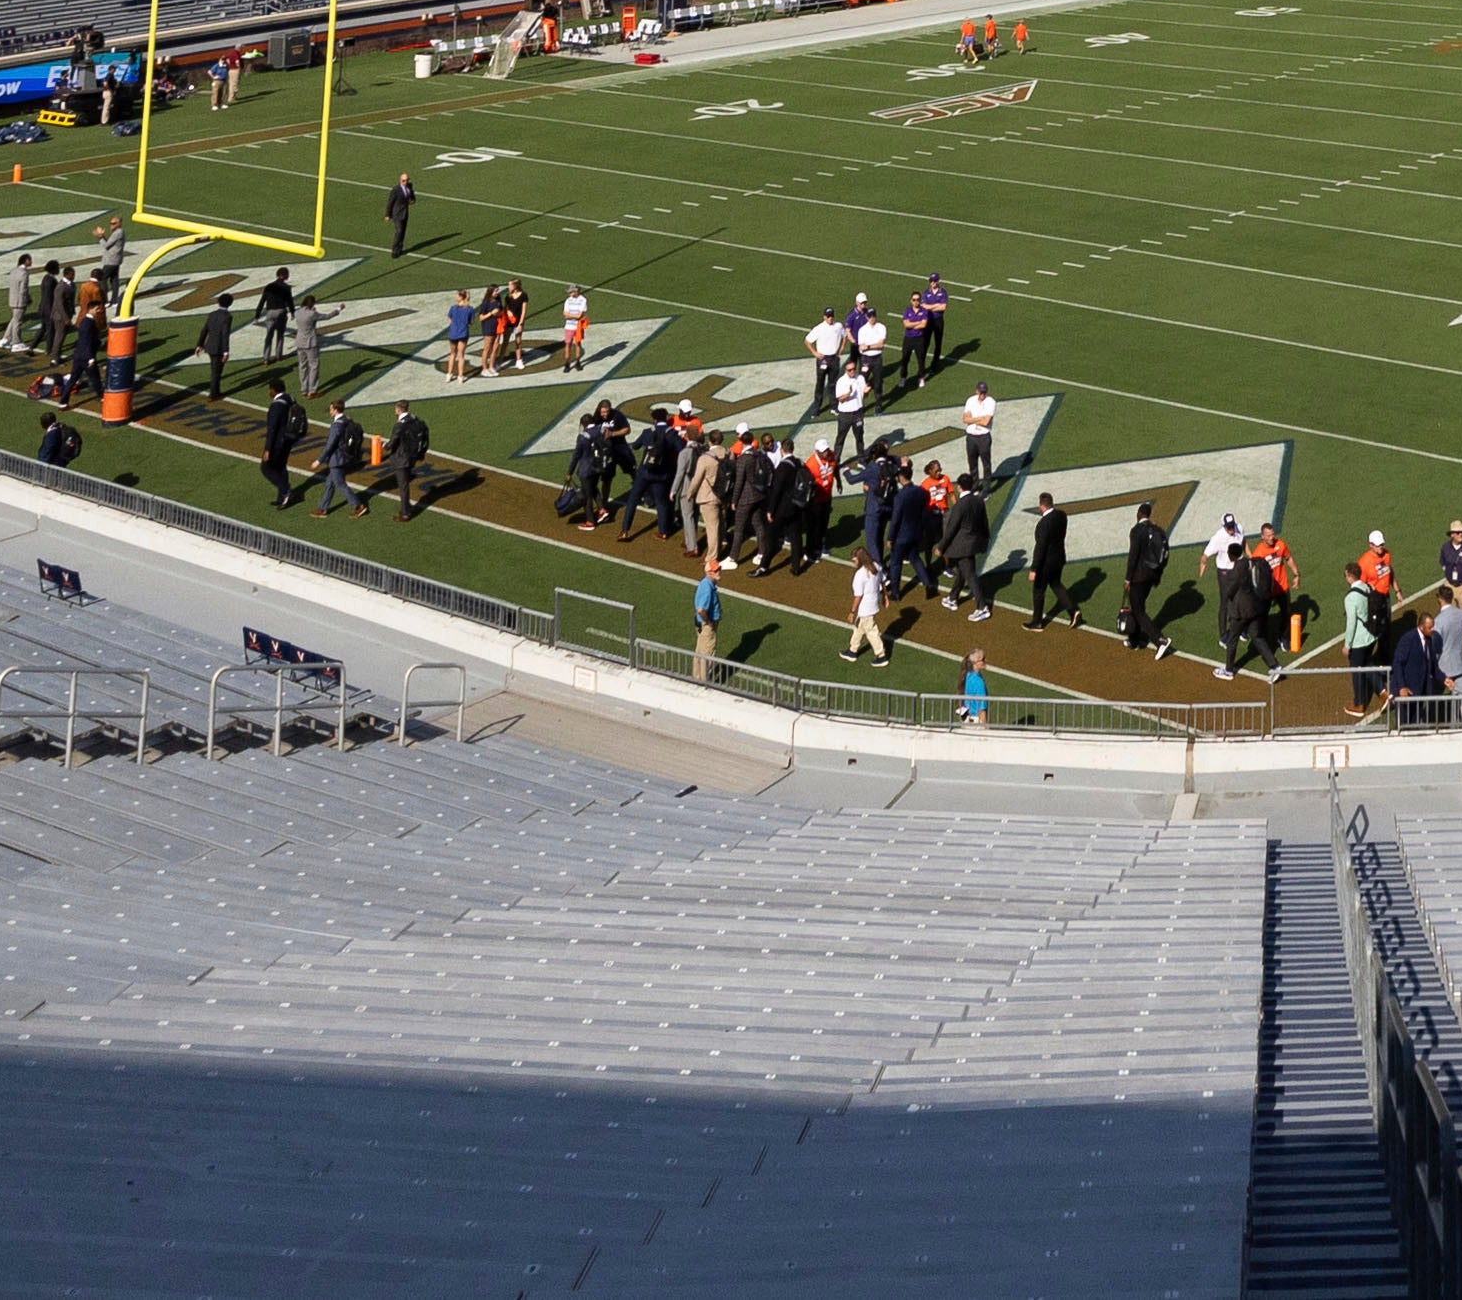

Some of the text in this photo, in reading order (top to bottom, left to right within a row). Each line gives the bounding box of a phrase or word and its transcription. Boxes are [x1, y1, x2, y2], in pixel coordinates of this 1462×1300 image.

[906, 63, 987, 78] 30
[694, 99, 784, 116] 20
[435, 147, 524, 163] 10
